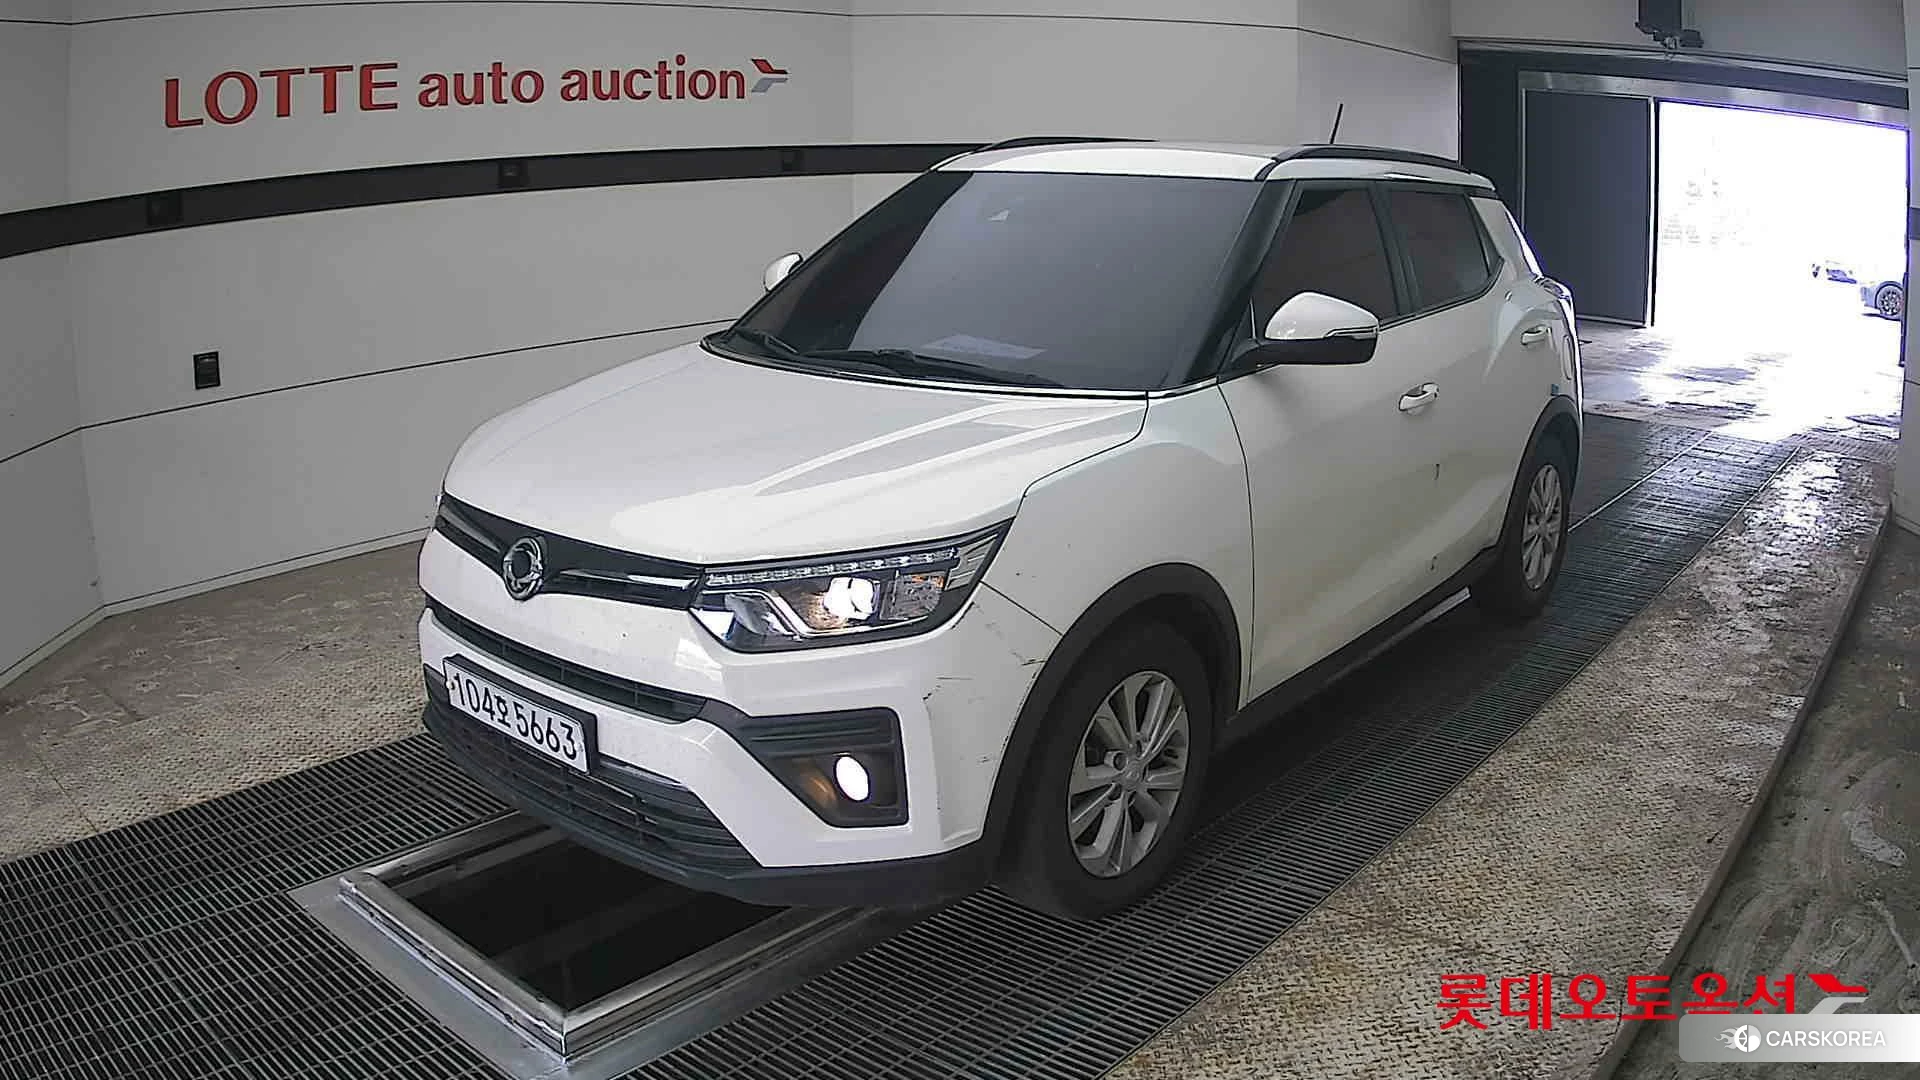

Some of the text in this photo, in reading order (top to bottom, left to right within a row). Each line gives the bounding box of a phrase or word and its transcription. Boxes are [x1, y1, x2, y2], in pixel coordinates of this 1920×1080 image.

[164, 54, 747, 129] LOTTE auto auction
